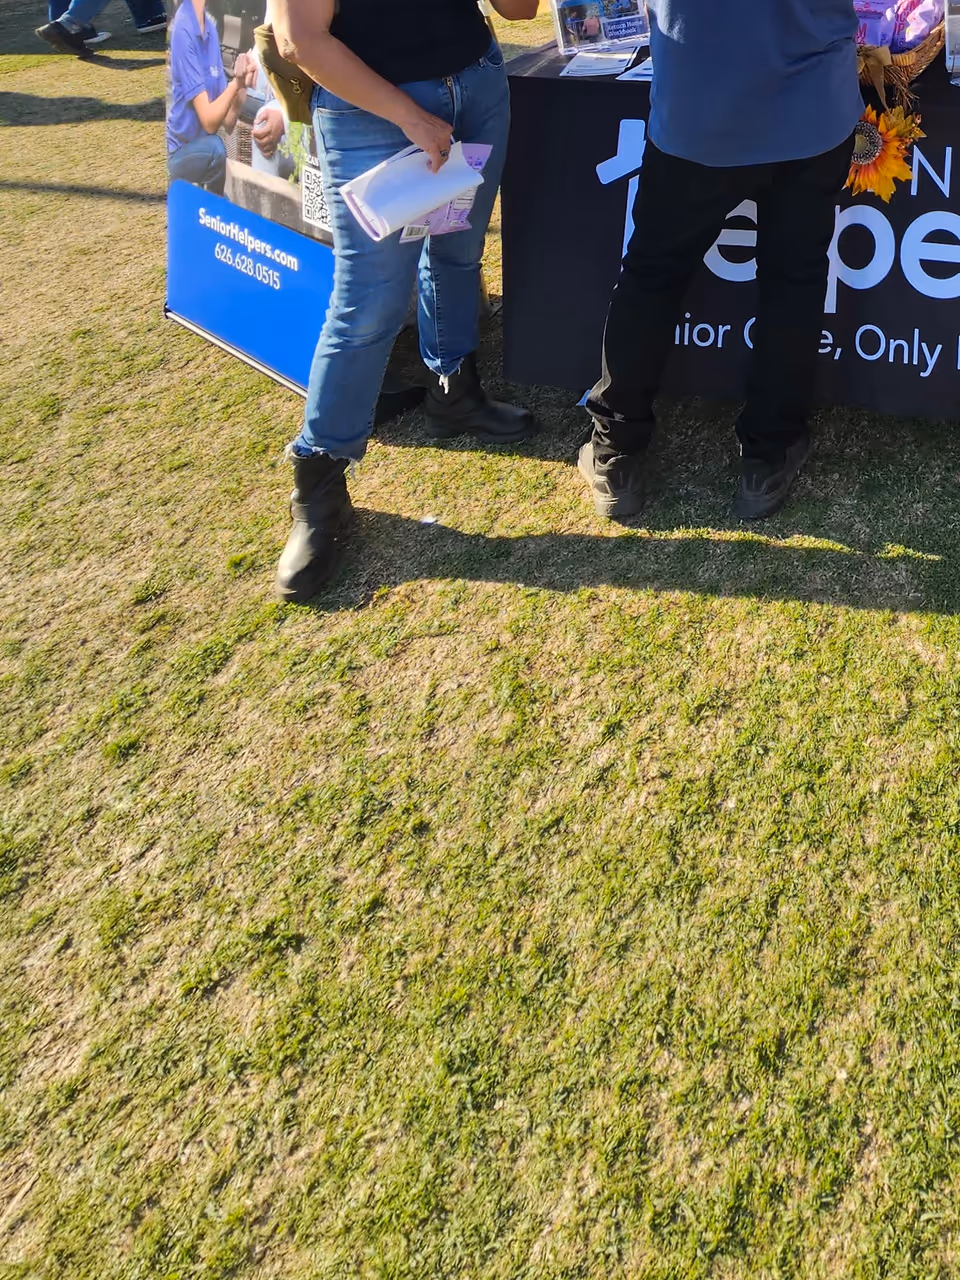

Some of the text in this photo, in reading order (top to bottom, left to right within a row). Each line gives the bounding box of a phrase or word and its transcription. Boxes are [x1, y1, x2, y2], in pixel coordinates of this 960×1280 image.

[608, 27, 637, 37] Workbook
[198, 207, 299, 271] SeniorHelpers.com
[214, 242, 281, 290] 626.628.0515
[855, 324, 942, 377] Only
